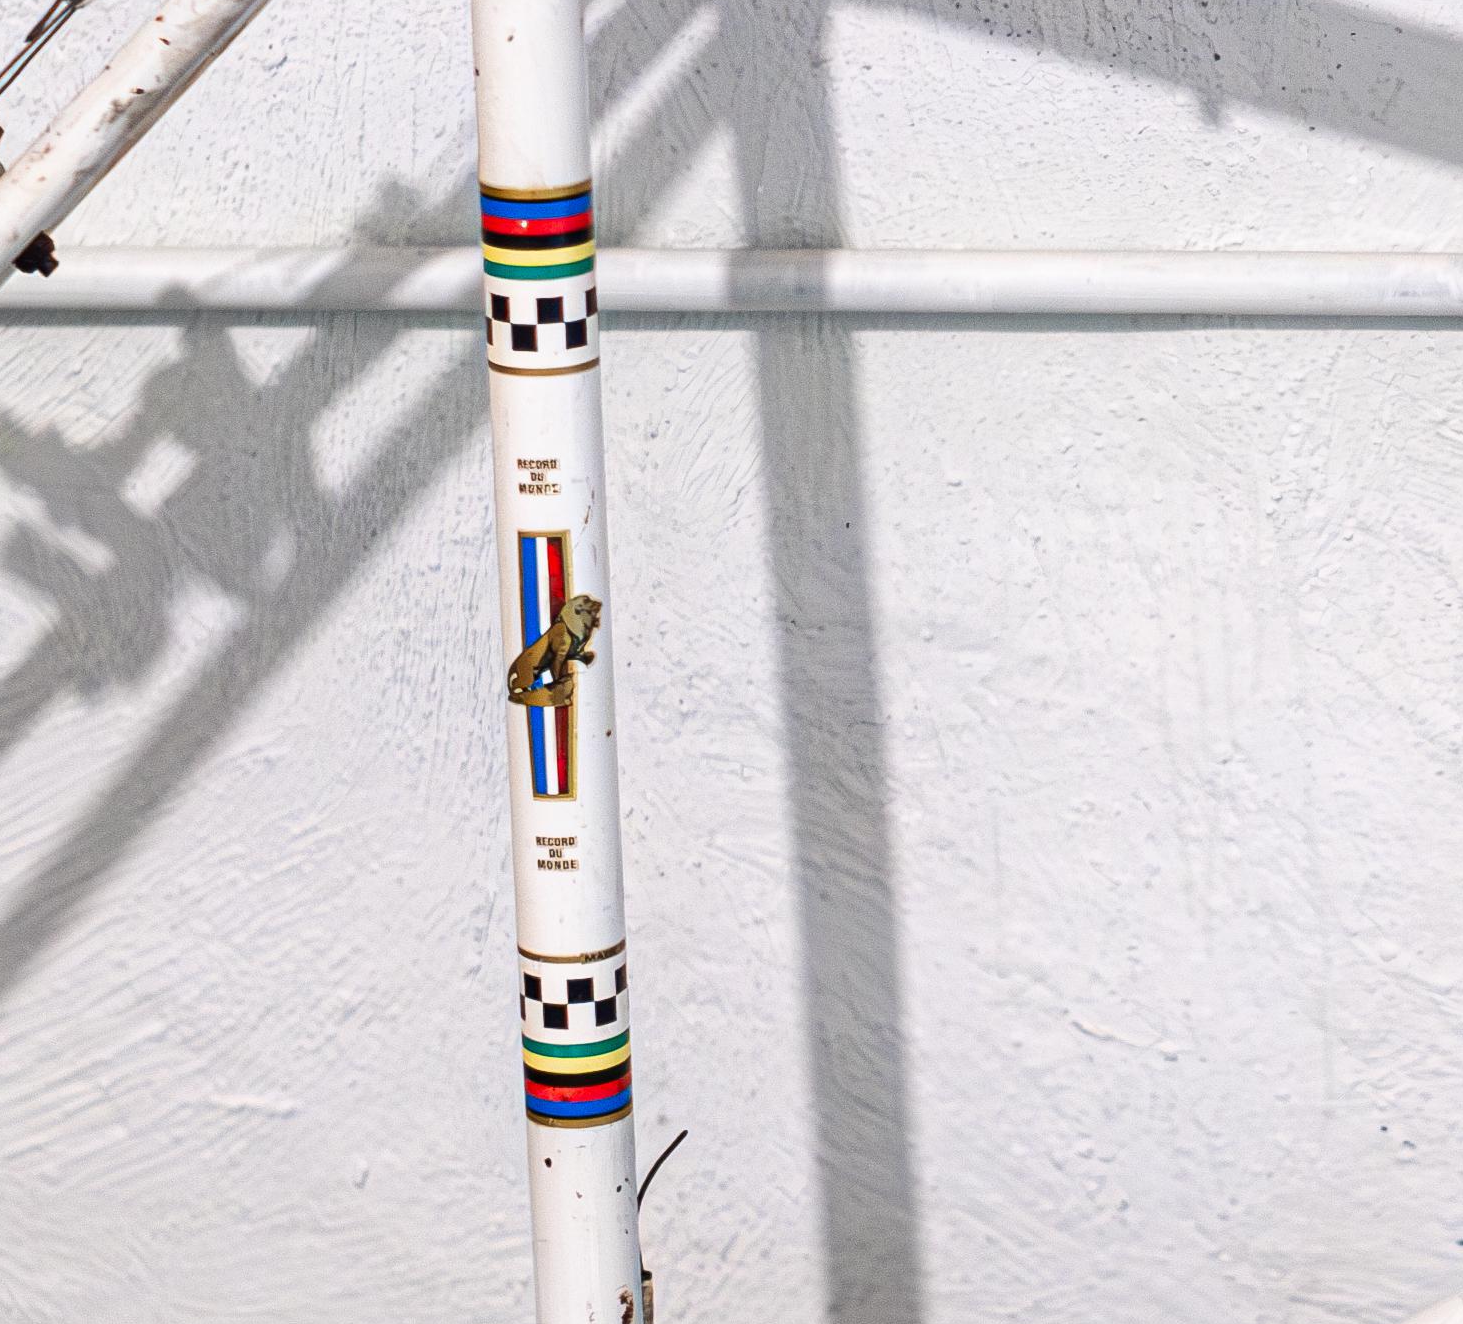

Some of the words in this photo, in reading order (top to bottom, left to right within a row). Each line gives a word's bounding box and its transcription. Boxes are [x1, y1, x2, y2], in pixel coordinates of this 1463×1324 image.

[516, 457, 558, 470] RECORD
[535, 836, 576, 847] RECORD
[548, 848, 563, 859] DU
[537, 859, 578, 871] MONDE
